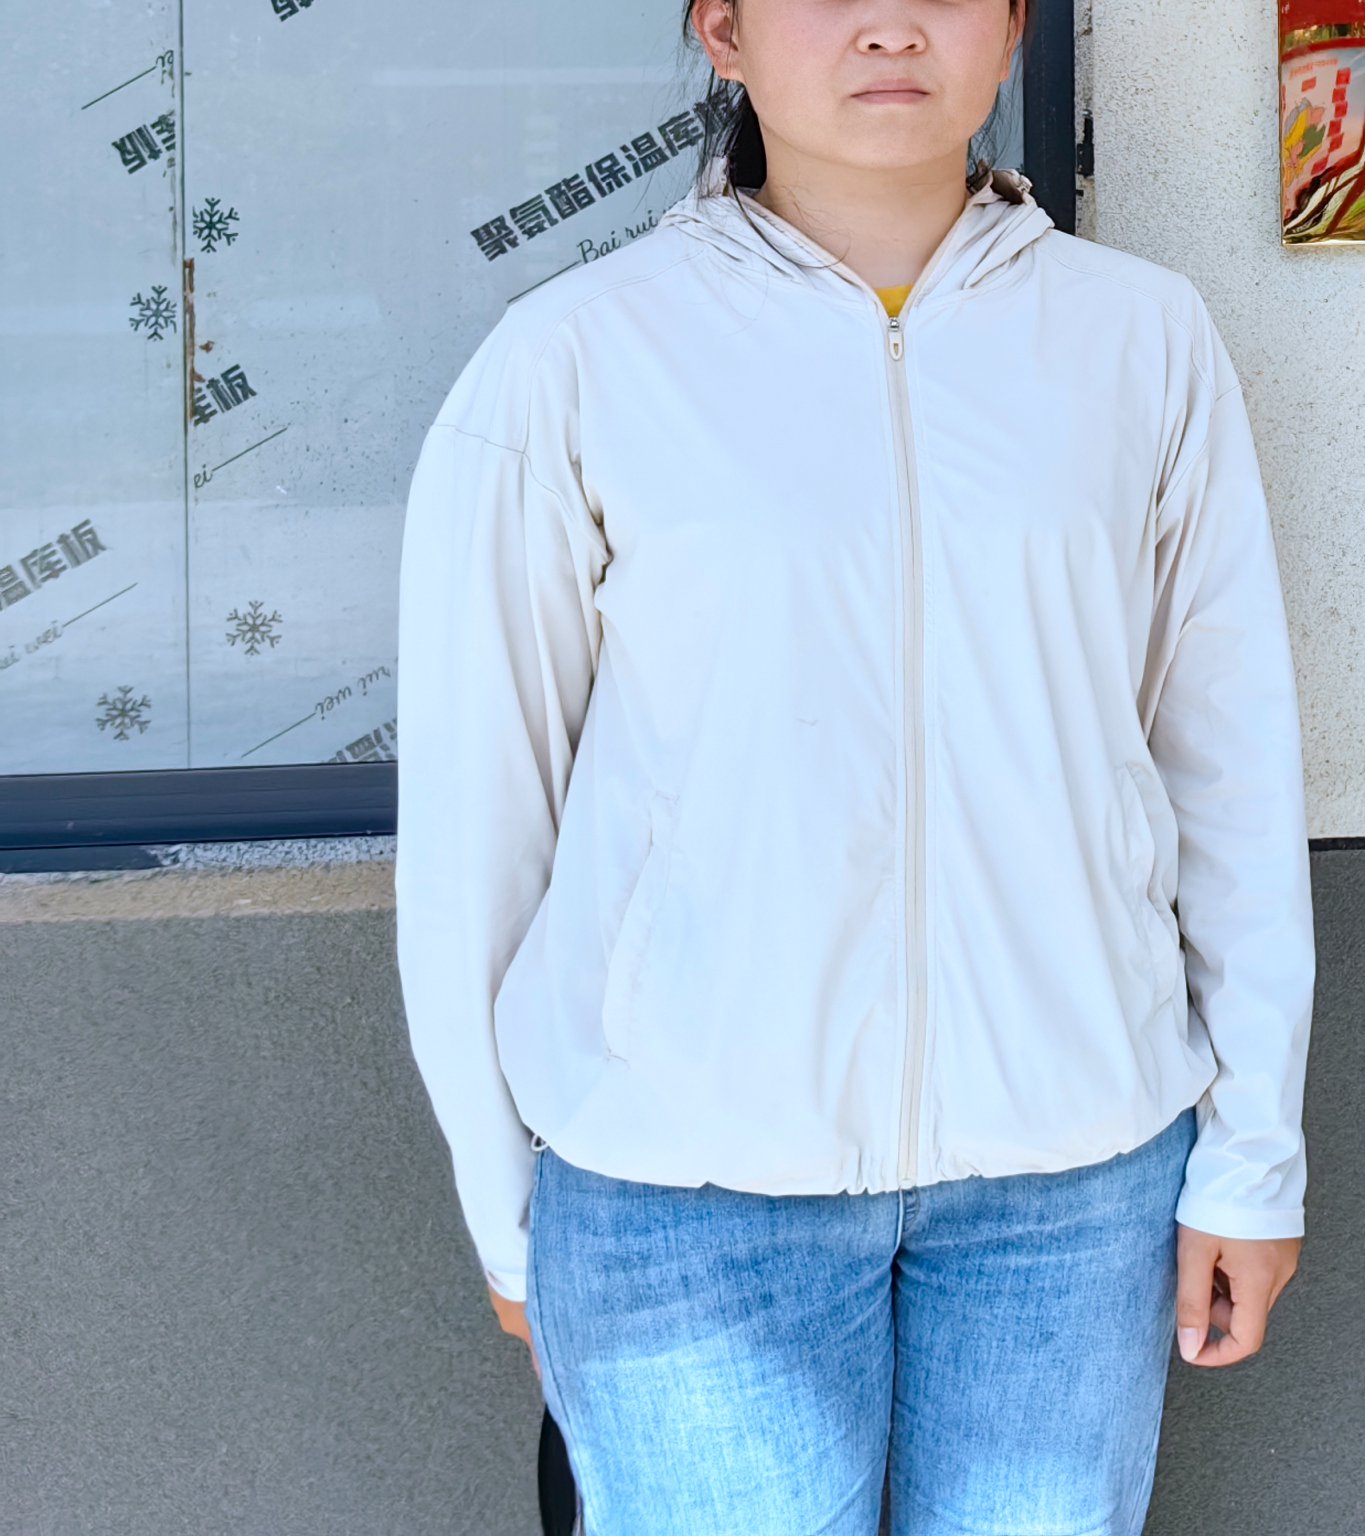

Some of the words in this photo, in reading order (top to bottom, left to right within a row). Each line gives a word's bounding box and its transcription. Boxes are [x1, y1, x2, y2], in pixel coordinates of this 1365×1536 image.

[576, 230, 621, 264] Bai
[625, 209, 659, 239] rui
[315, 686, 352, 720] wei
